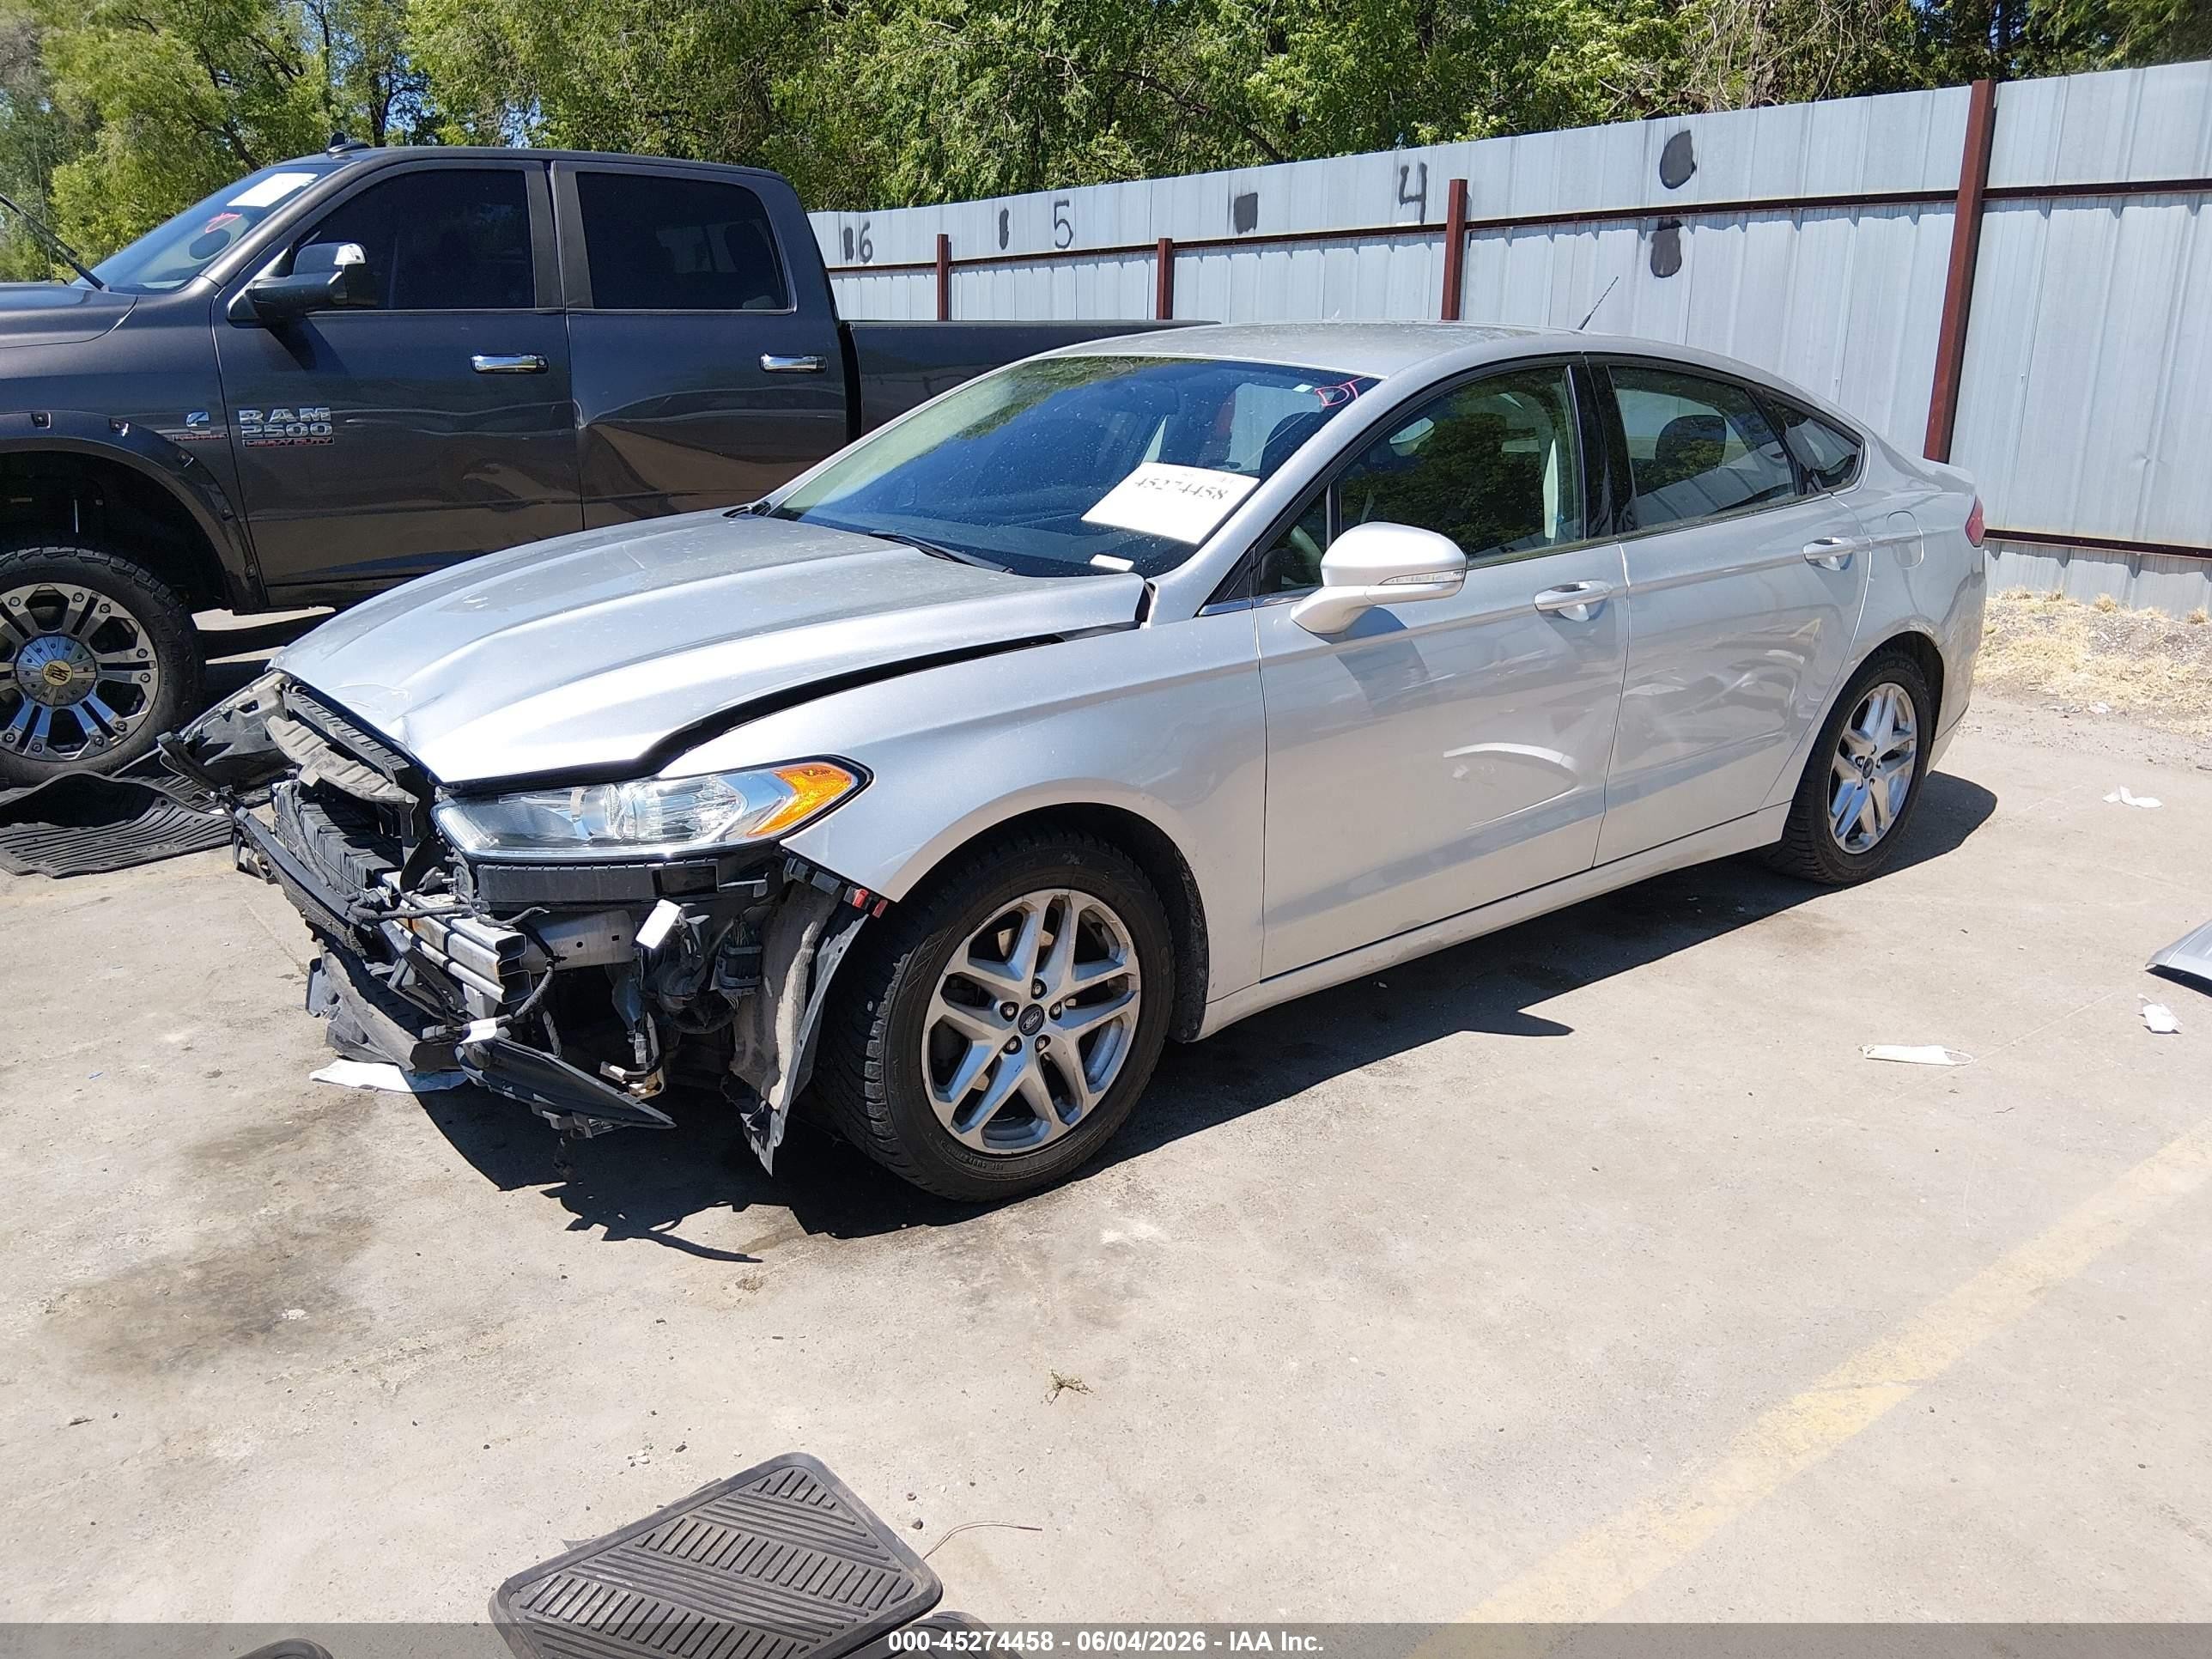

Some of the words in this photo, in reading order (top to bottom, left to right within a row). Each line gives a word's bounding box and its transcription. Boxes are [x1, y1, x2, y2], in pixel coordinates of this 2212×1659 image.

[1398, 161, 1429, 225] 4
[1054, 198, 1073, 249] 5
[239, 407, 331, 424] RAM
[240, 422, 333, 440] 2500
